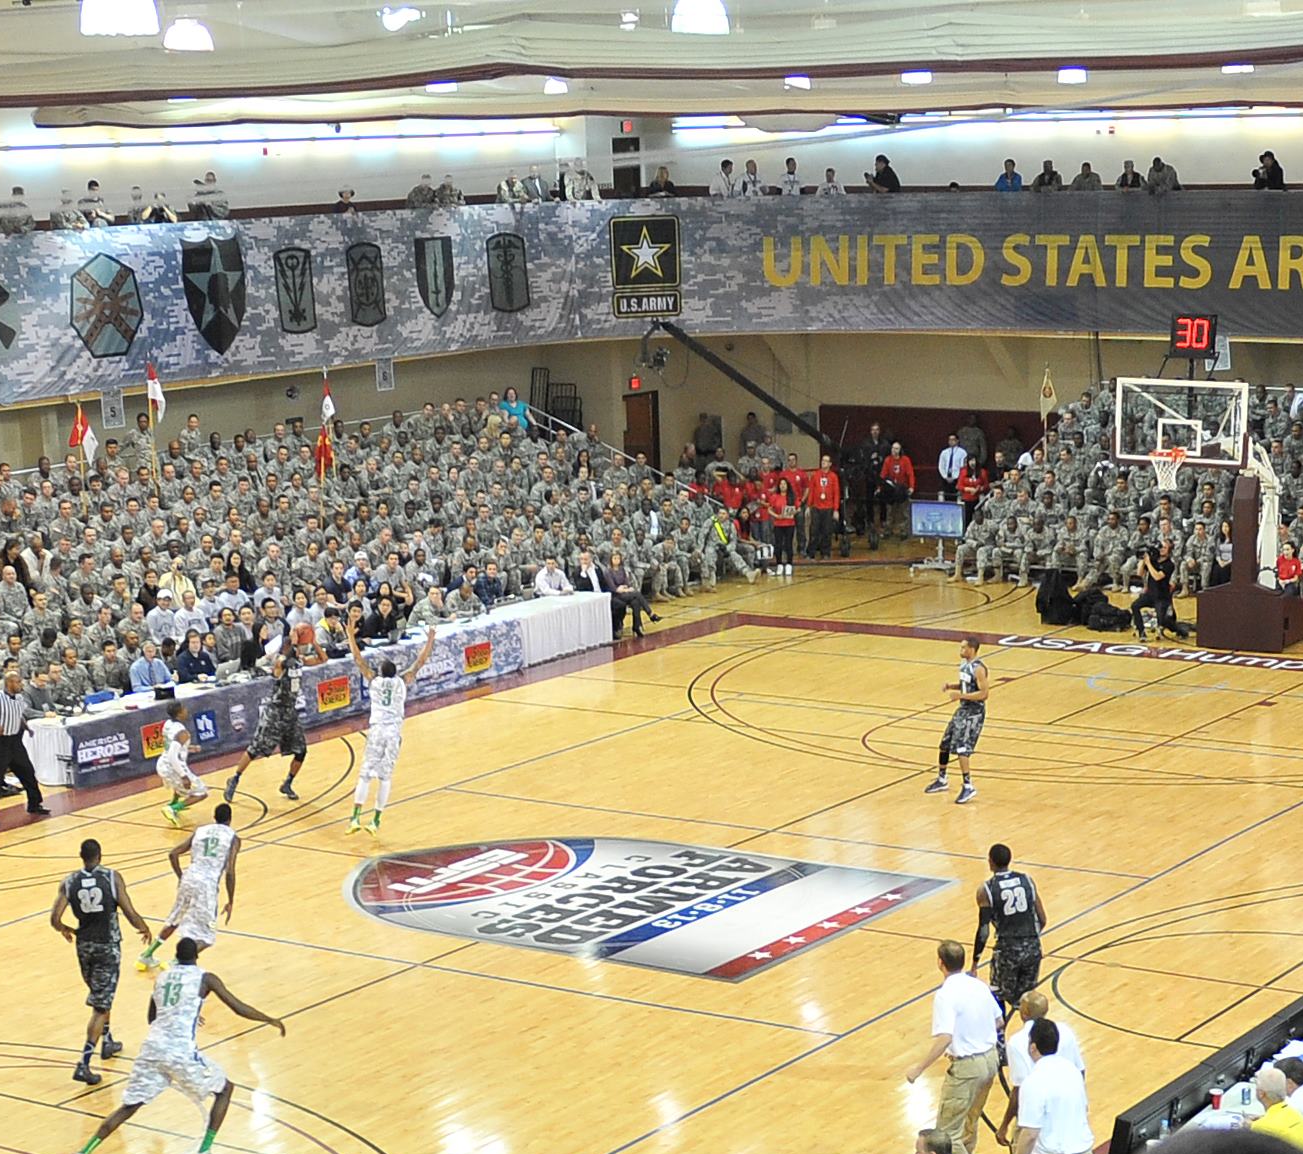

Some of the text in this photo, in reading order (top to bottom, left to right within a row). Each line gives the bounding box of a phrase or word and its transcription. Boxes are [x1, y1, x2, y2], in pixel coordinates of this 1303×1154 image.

[762, 234, 985, 286] UNITED
[1000, 233, 1212, 290] STATES
[1176, 318, 1210, 349] 30
[998, 635, 1148, 656] USAG
[382, 688, 392, 706] 3
[77, 740, 130, 764] HEROES
[78, 733, 125, 749] AMERICA'S
[201, 837, 219, 857] 12
[387, 848, 529, 894] ESPN
[77, 886, 104, 913] 32
[471, 855, 652, 919] CLASSIC
[476, 849, 728, 938] FORCES
[535, 856, 773, 945] ARMED
[1001, 886, 1028, 915] 23
[162, 982, 184, 1007] 13
